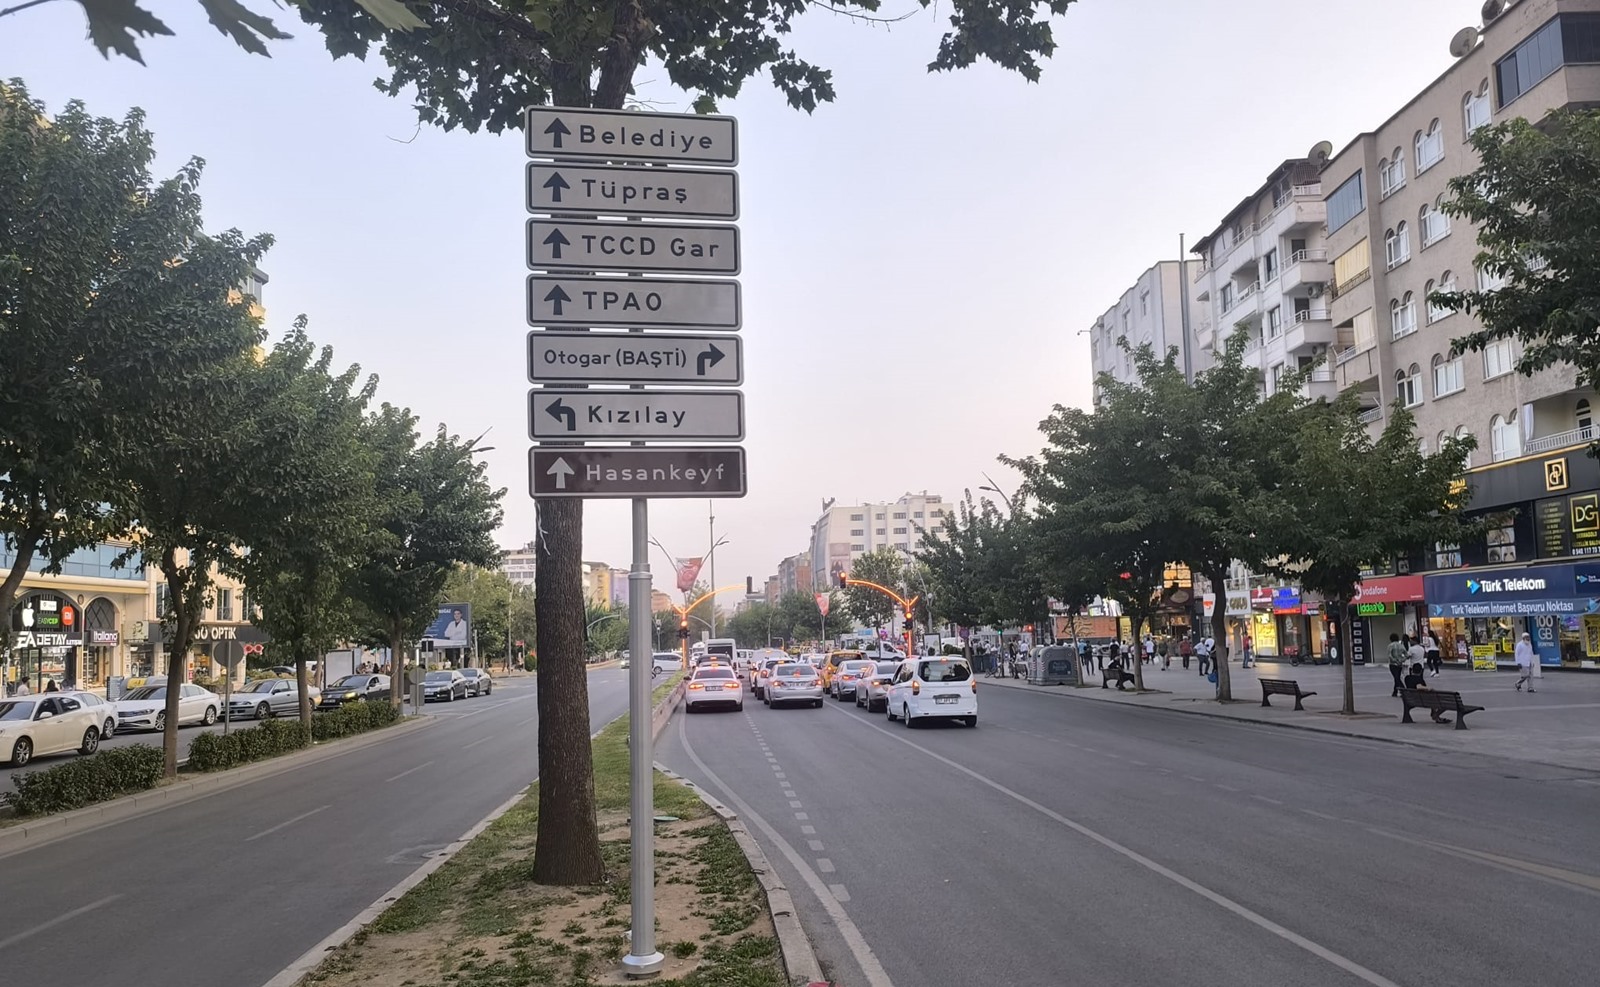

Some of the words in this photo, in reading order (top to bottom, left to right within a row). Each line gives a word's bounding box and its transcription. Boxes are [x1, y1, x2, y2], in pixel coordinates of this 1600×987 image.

[579, 124, 713, 153] Belediye
[581, 178, 688, 205] Tüpraş
[581, 235, 656, 256] TCCD
[670, 238, 719, 258] Gar
[582, 291, 662, 312] TPAO
[543, 349, 611, 368] Otogar
[615, 347, 687, 369] (BAŞTİ)
[588, 405, 686, 429] Kızılay
[586, 463, 725, 485] Hasankeyf
[1362, 585, 1388, 595] vodafone
[1480, 580, 1502, 593] Türk
[1503, 577, 1545, 591] Telekom
[1450, 605, 1465, 614] Türk
[1465, 602, 1490, 614] Telekom
[1491, 601, 1517, 613] İnternet
[1518, 602, 1545, 615] Başvuru
[1547, 600, 1574, 612] Noktası
[1535, 615, 1554, 627] 100
[1538, 628, 1553, 640] GB
